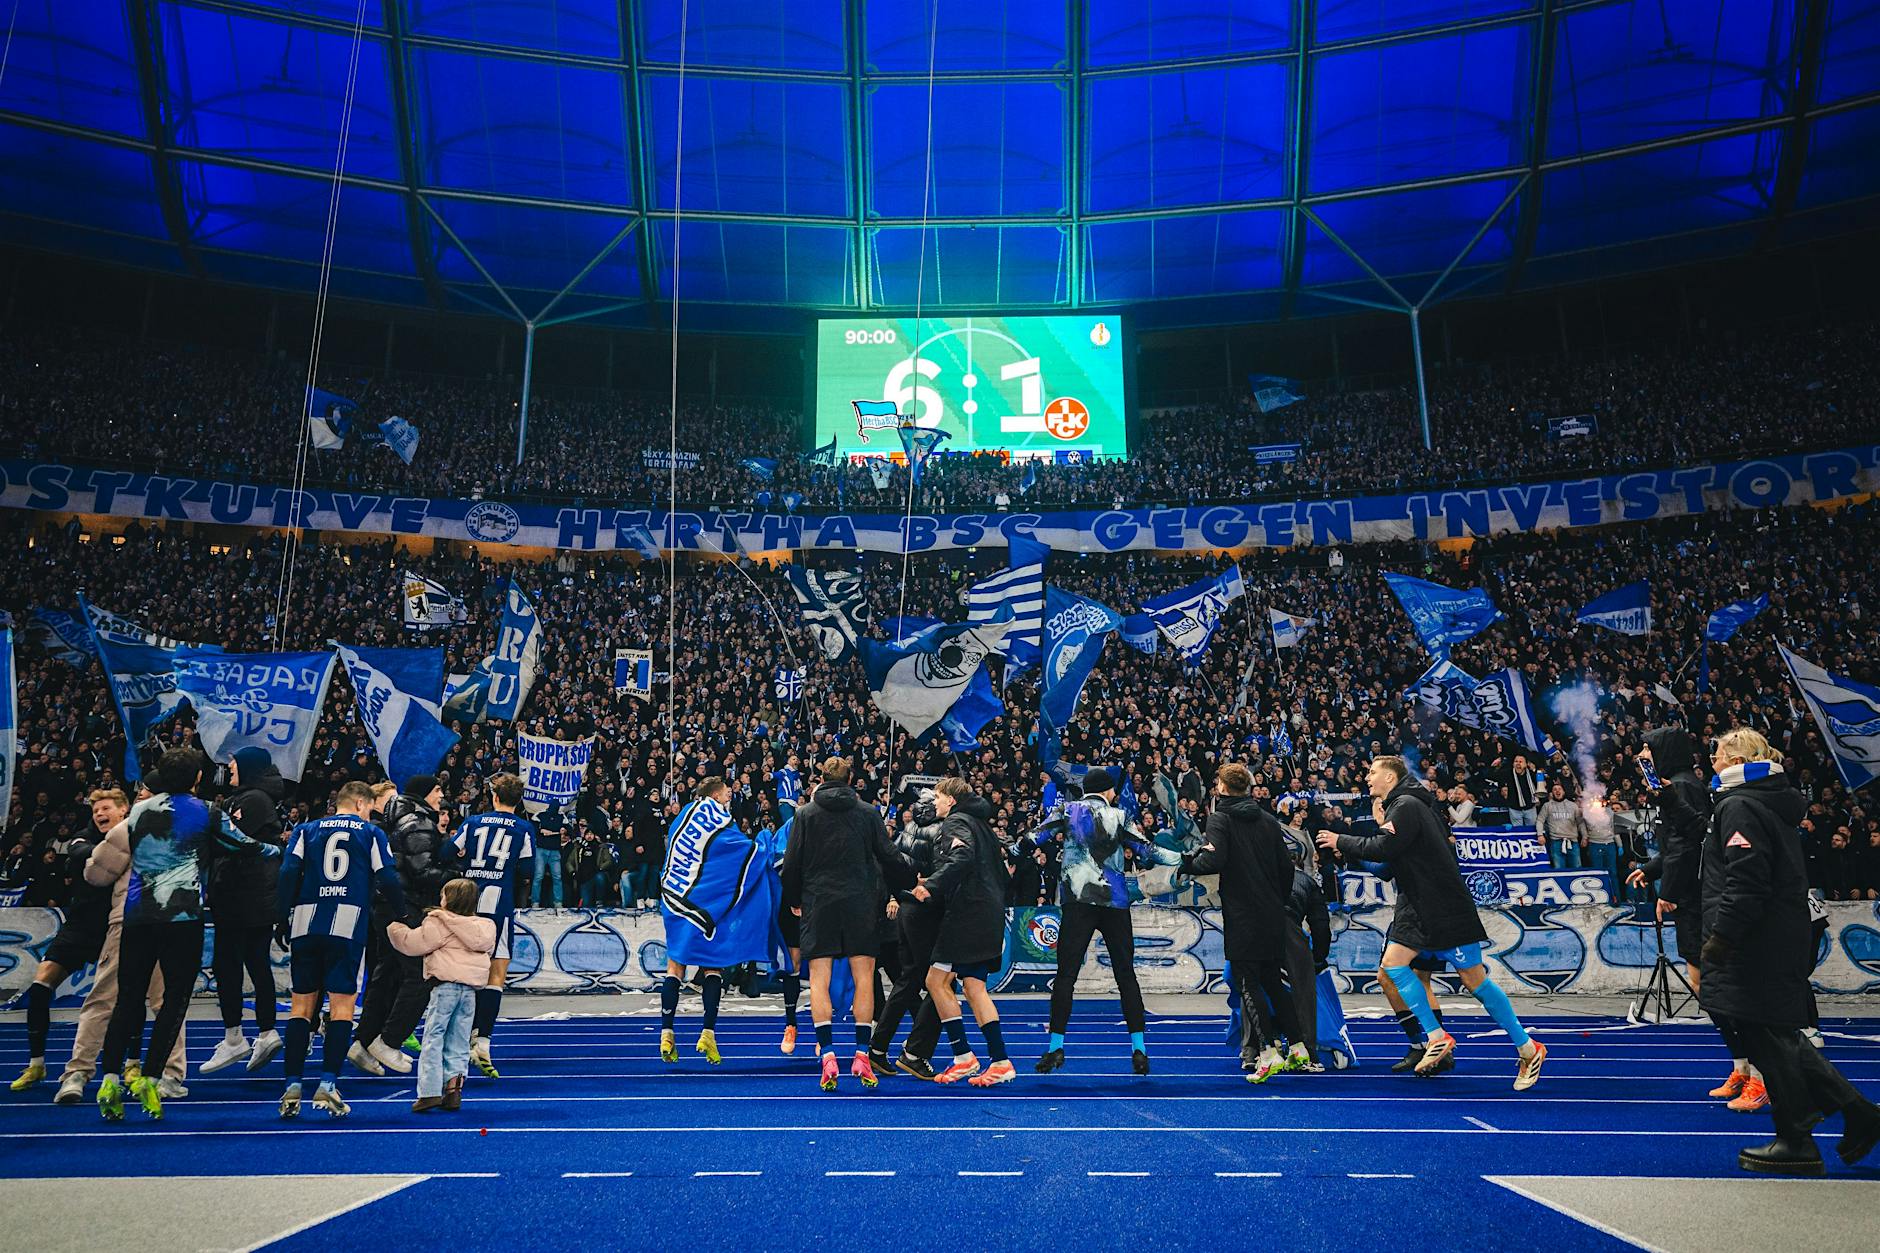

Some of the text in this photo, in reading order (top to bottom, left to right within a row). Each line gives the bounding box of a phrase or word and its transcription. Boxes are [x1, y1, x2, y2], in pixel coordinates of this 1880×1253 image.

[845, 329, 896, 344] 90:00
[883, 358, 943, 430] 6
[1001, 357, 1047, 432] 1
[0, 464, 430, 533] STKURVE
[556, 508, 858, 553] HERTHA
[1093, 500, 1354, 550] GEGEN
[1406, 446, 1880, 540] INVESTOR
[520, 737, 568, 767] GRUPPA
[528, 766, 581, 793] BERLIN
[320, 820, 364, 830] HERTHA BSC
[480, 816, 516, 827] HERTHA BSC
[323, 831, 351, 882] 6
[470, 826, 513, 870] 14
[319, 886, 347, 897] DEMME
